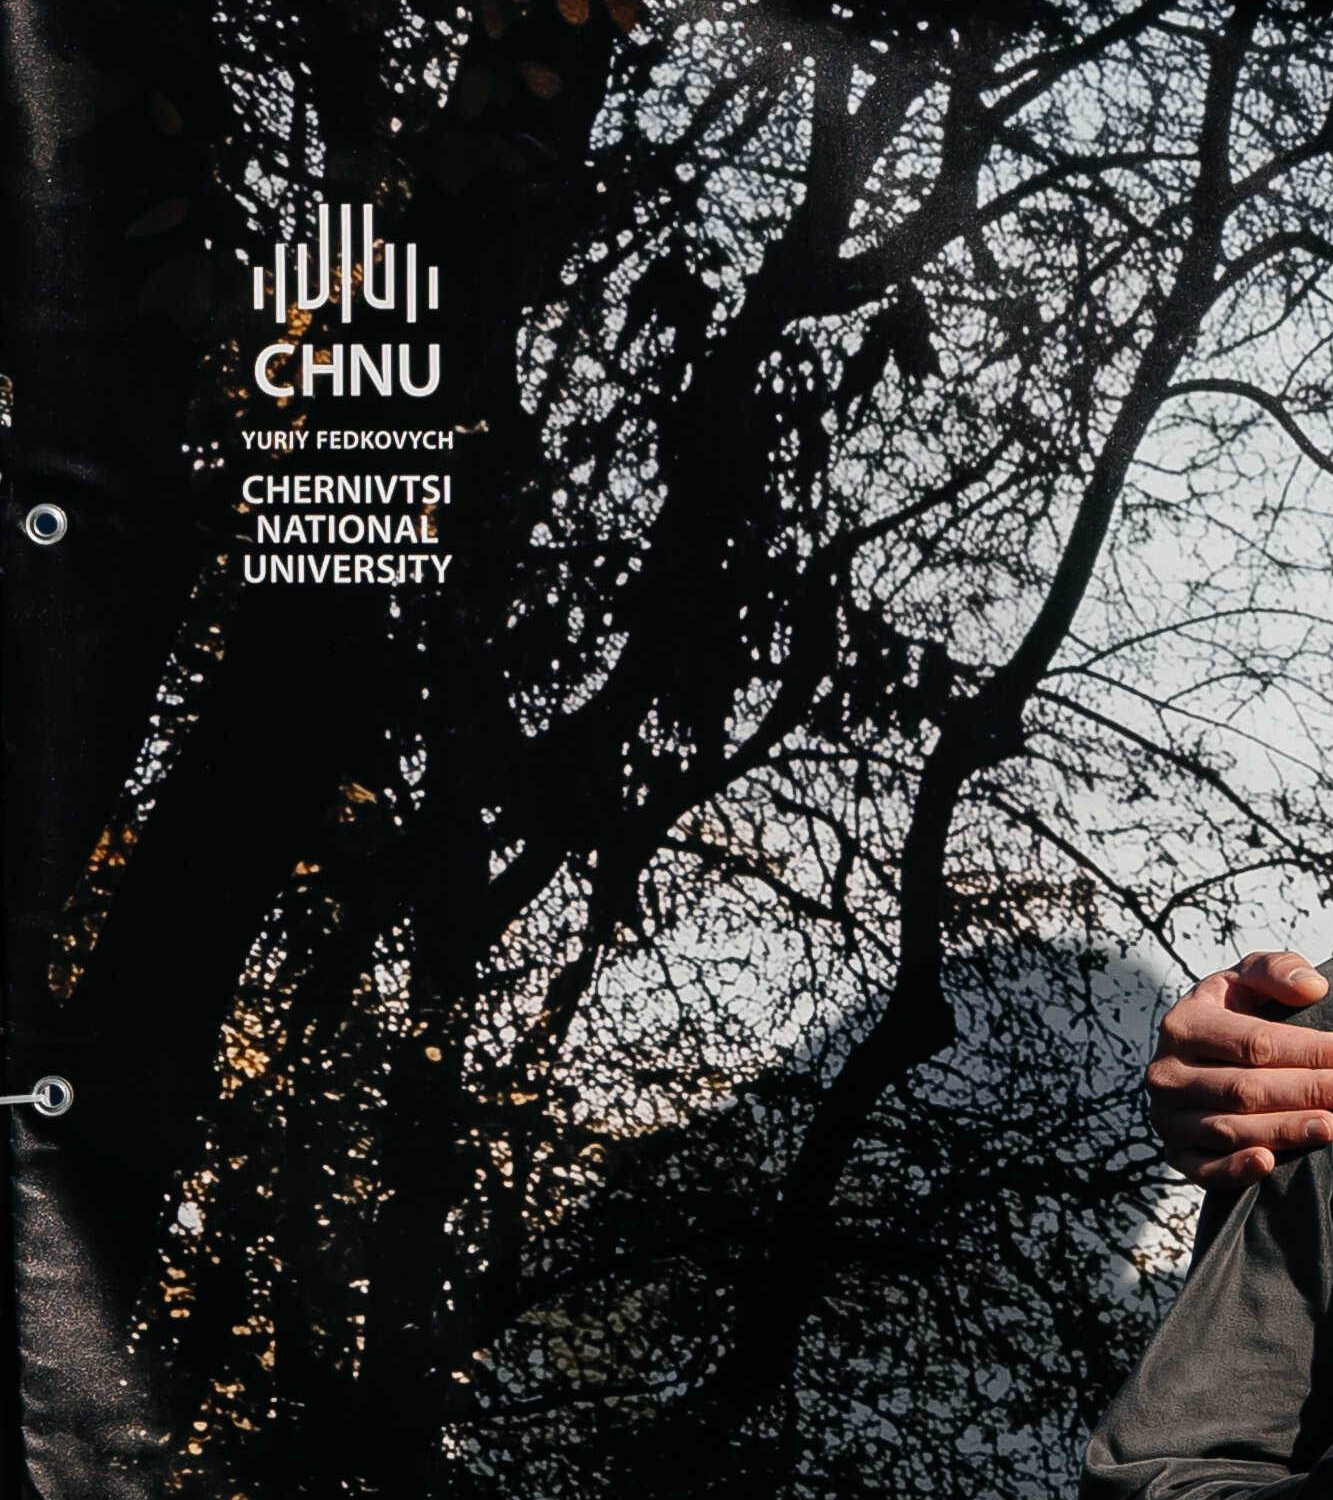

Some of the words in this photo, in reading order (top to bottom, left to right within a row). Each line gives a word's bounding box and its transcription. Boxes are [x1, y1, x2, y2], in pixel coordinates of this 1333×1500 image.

[254, 342, 442, 398] CHNU
[241, 429, 310, 451] YURIY
[316, 429, 455, 451] FEDKOVYCH
[241, 473, 452, 505] CHERNIVTSI
[256, 513, 440, 545] NATIONAL
[242, 553, 453, 585] UNIVERSITY
